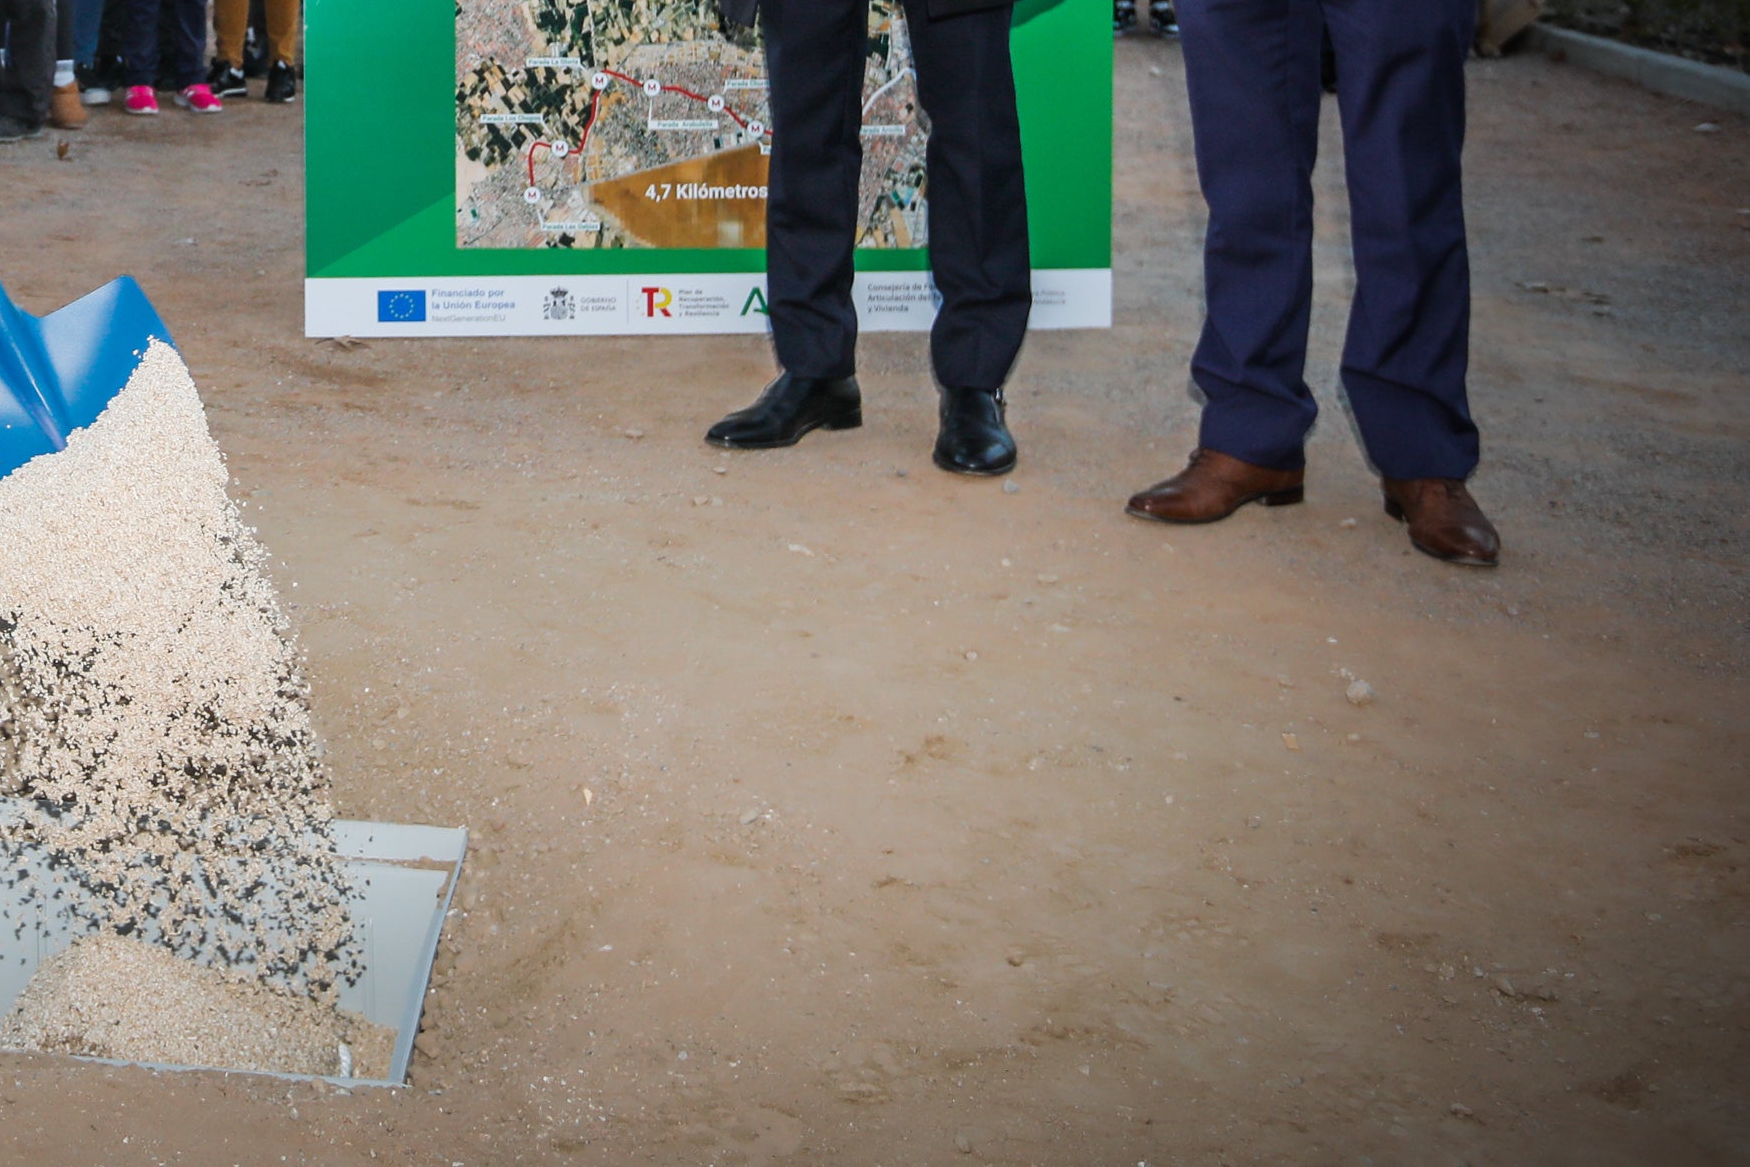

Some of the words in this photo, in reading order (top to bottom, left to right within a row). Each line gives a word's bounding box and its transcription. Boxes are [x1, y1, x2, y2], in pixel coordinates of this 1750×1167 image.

[645, 183, 671, 203] 4,7
[676, 182, 769, 201] Kilómetros
[431, 288, 486, 297] Financiado
[488, 289, 505, 299] por
[432, 301, 440, 309] la
[443, 300, 472, 309] Unión
[474, 300, 515, 311] Europea
